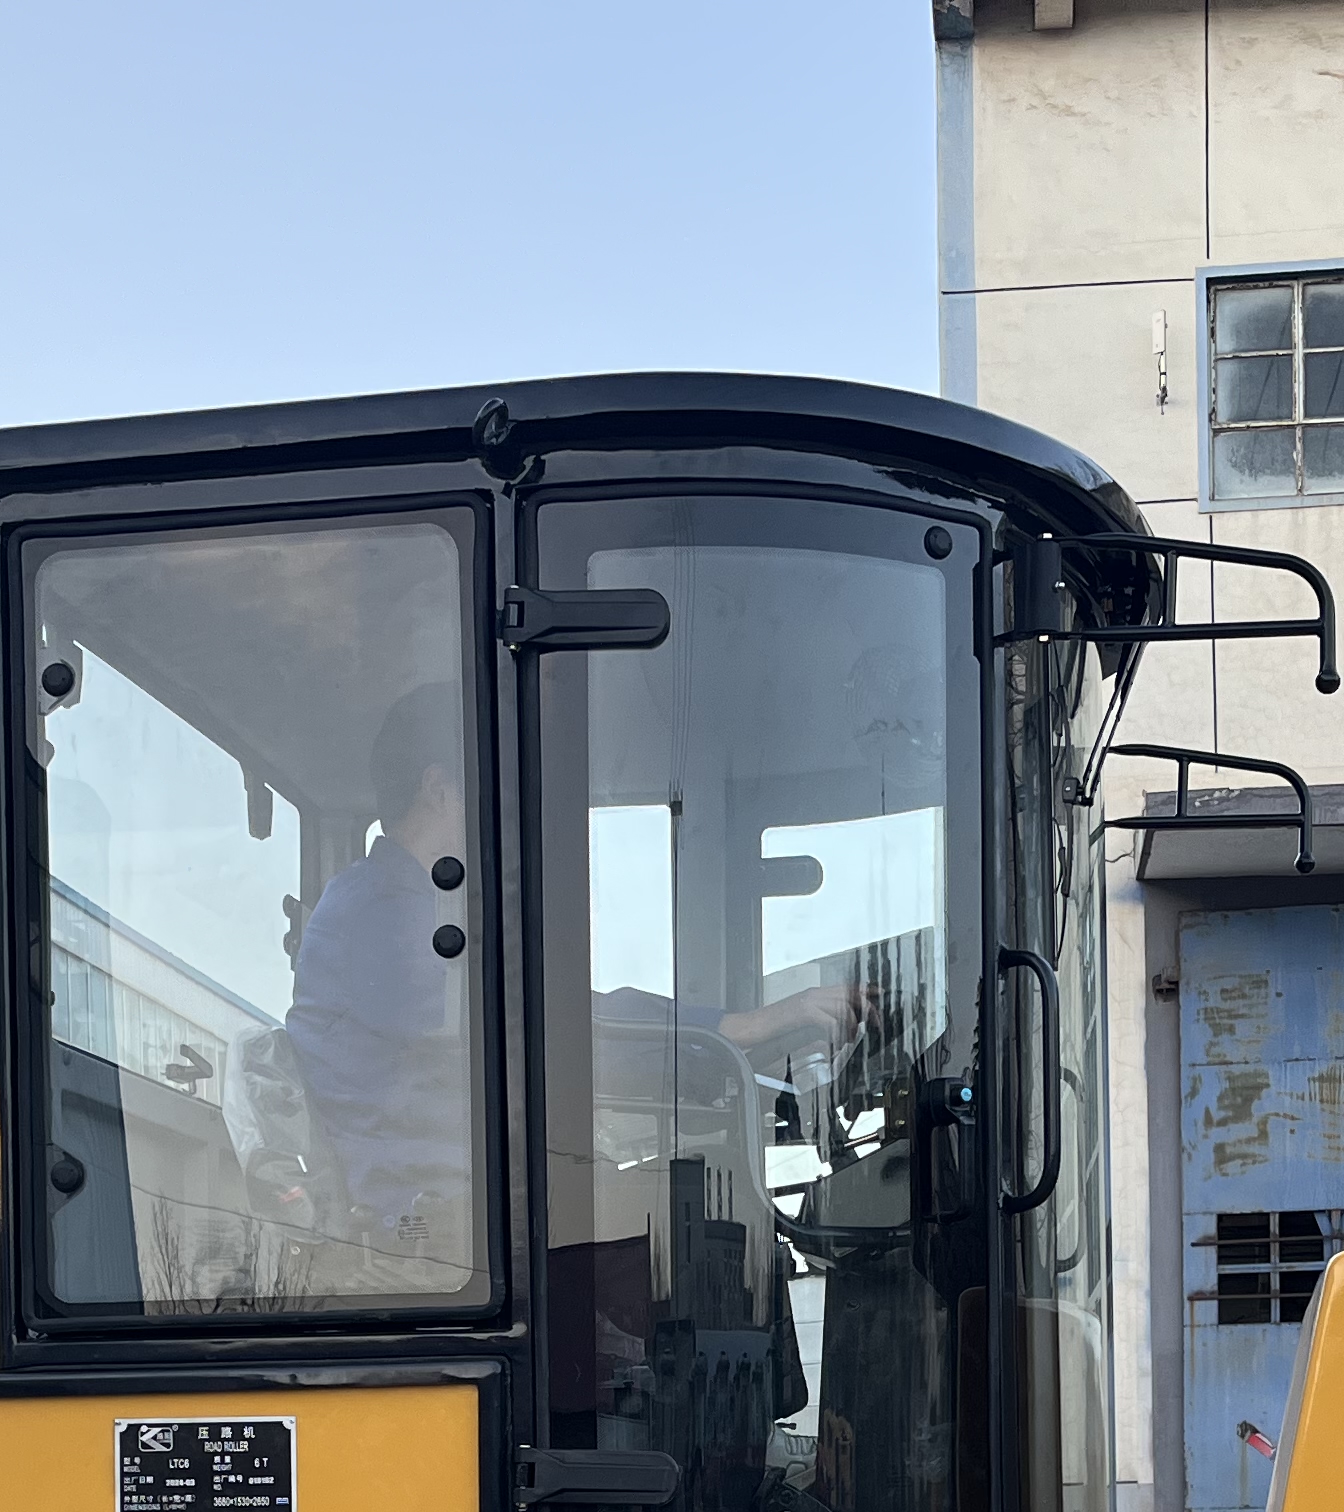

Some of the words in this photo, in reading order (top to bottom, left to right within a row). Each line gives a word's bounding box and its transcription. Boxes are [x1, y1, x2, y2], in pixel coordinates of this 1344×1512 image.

[204, 1441, 222, 1452] ROAD
[224, 1441, 249, 1452] ROLLER
[169, 1458, 190, 1469] LTC6
